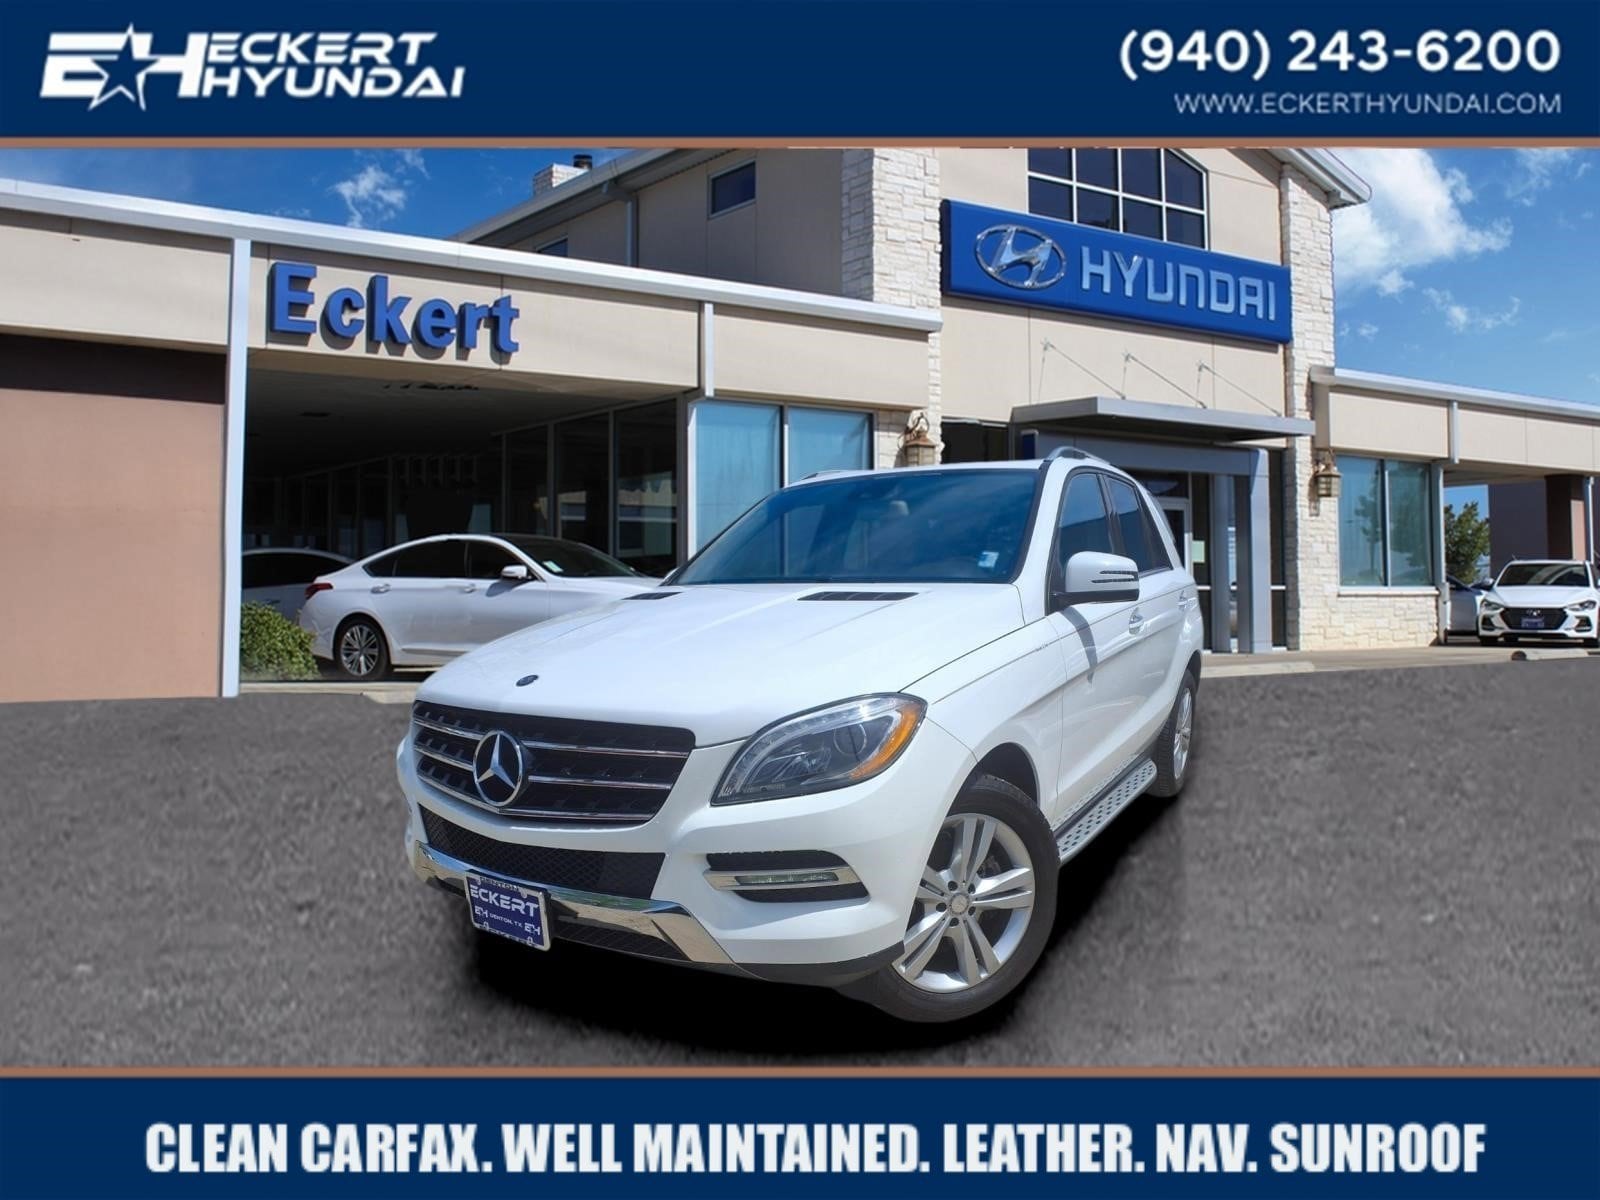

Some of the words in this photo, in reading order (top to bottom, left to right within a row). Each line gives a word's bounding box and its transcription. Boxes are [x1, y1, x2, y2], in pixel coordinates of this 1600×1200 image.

[267, 261, 520, 354] Eckert
[1080, 244, 1277, 322] HYUNDAI
[469, 883, 540, 917] ECKERT
